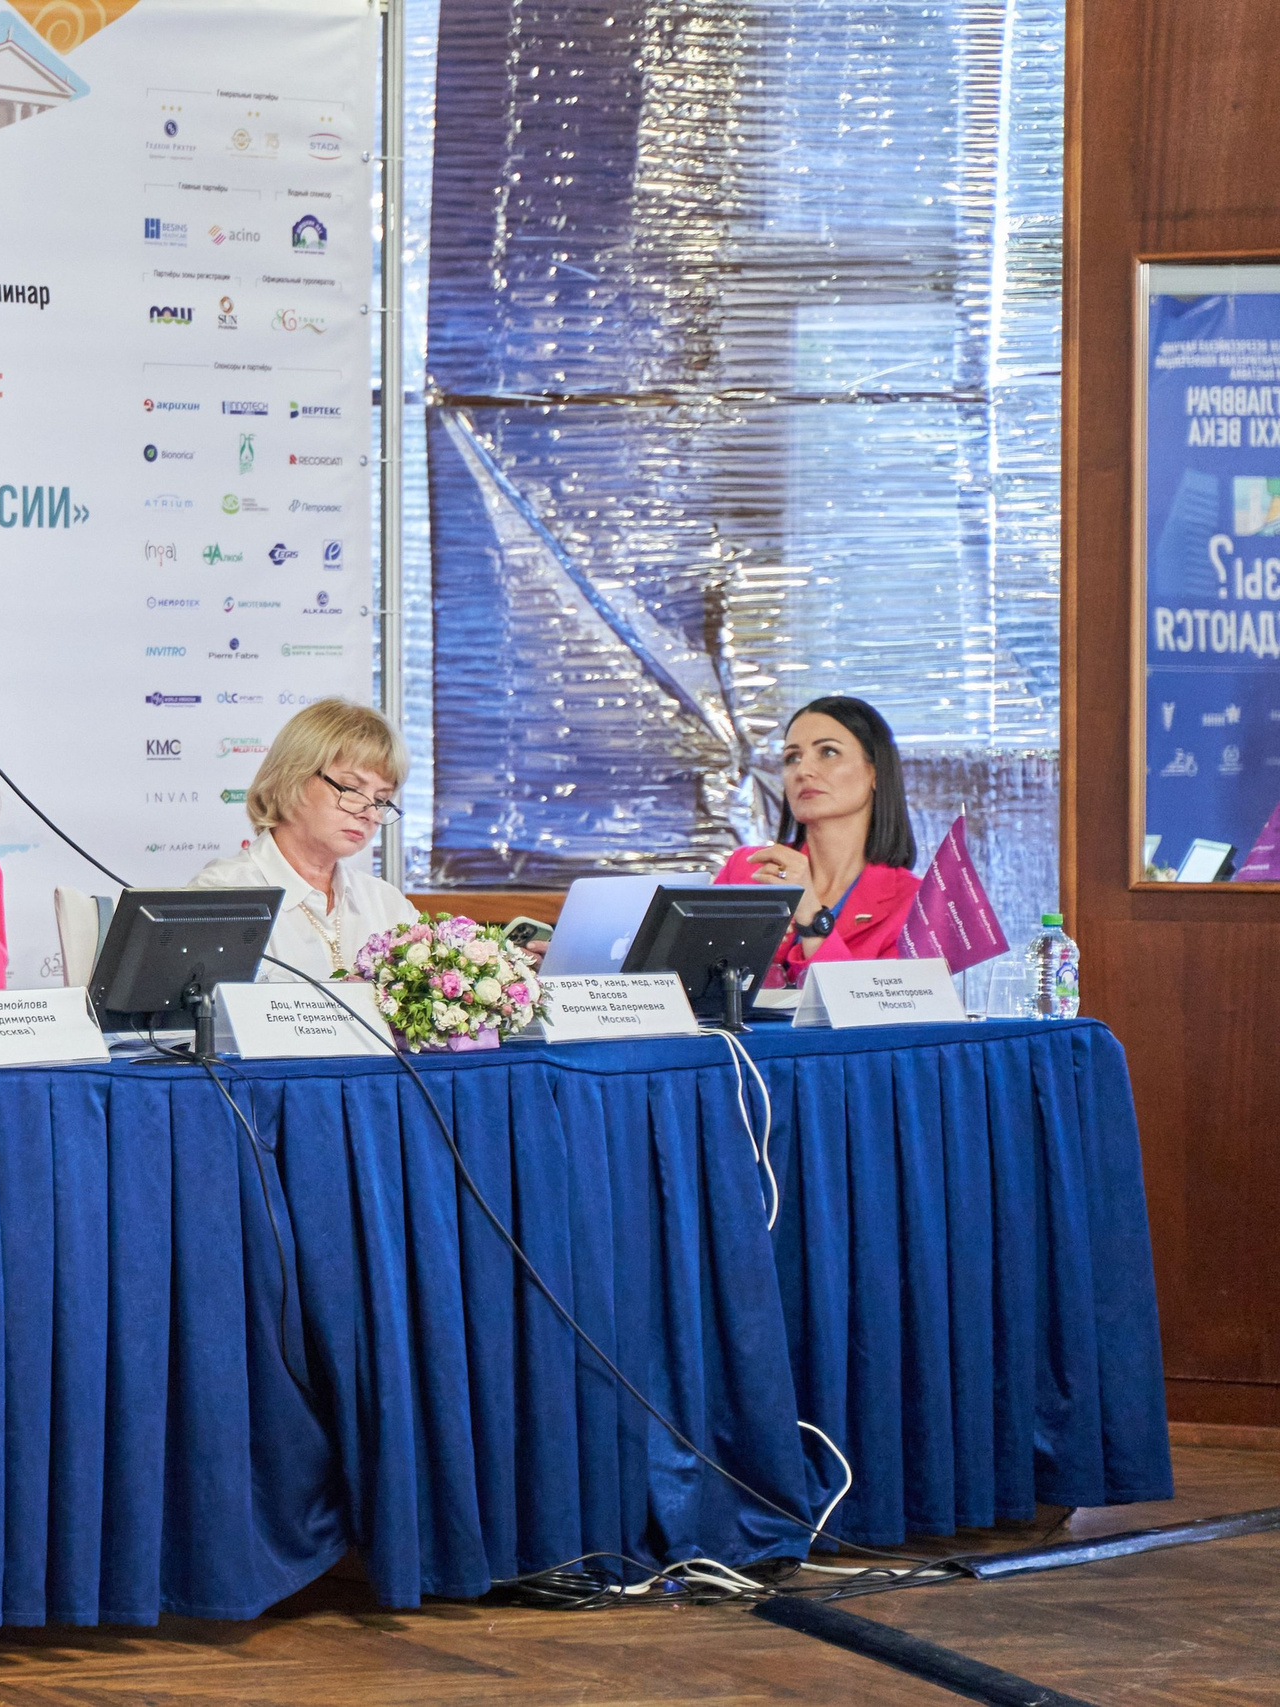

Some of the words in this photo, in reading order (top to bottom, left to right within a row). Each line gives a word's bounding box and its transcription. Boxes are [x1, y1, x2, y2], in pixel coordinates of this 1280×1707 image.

[309, 141, 340, 152] STADA
[162, 223, 187, 233] BESINS
[228, 229, 261, 242] acino
[153, 269, 180, 280] Партнёры
[262, 275, 302, 286] Официальный
[218, 314, 238, 325] SUN
[214, 362, 241, 371] Спонсоры
[156, 401, 200, 411] акрихин
[302, 406, 341, 416] ВЕРТЕКС
[161, 450, 193, 460] Bionorica
[299, 457, 343, 466] RECORDATI
[302, 503, 342, 513] Петровакс
[277, 550, 299, 559] EGIS
[146, 646, 186, 657] INVITRO
[208, 652, 232, 660] Pierre
[235, 652, 259, 660] Fabre
[961, 867, 979, 903] StatusPraesens
[947, 901, 972, 950] StatusPraesens
[979, 908, 997, 945] StatusPraesens
[561, 980, 582, 989] врач
[585, 979, 602, 989] РФ,
[604, 979, 629, 988] канд.
[631, 979, 652, 988] мед.
[654, 979, 676, 987] наук
[872, 977, 903, 987] Буцкая
[589, 990, 628, 999] Власова
[849, 990, 884, 999] Татьяна
[885, 988, 933, 998] Викторовна
[271, 1000, 292, 1010] Доц.
[294, 1000, 344, 1009] Игнашина
[562, 1003, 607, 1013] Вероника
[609, 1002, 666, 1012] Валериевна
[878, 1000, 916, 1011] (Москва)
[266, 1013, 295, 1023] Елена
[297, 1013, 354, 1023] Германовна
[597, 1015, 641, 1025] (Москва)
[294, 1025, 337, 1036] (Казань)
